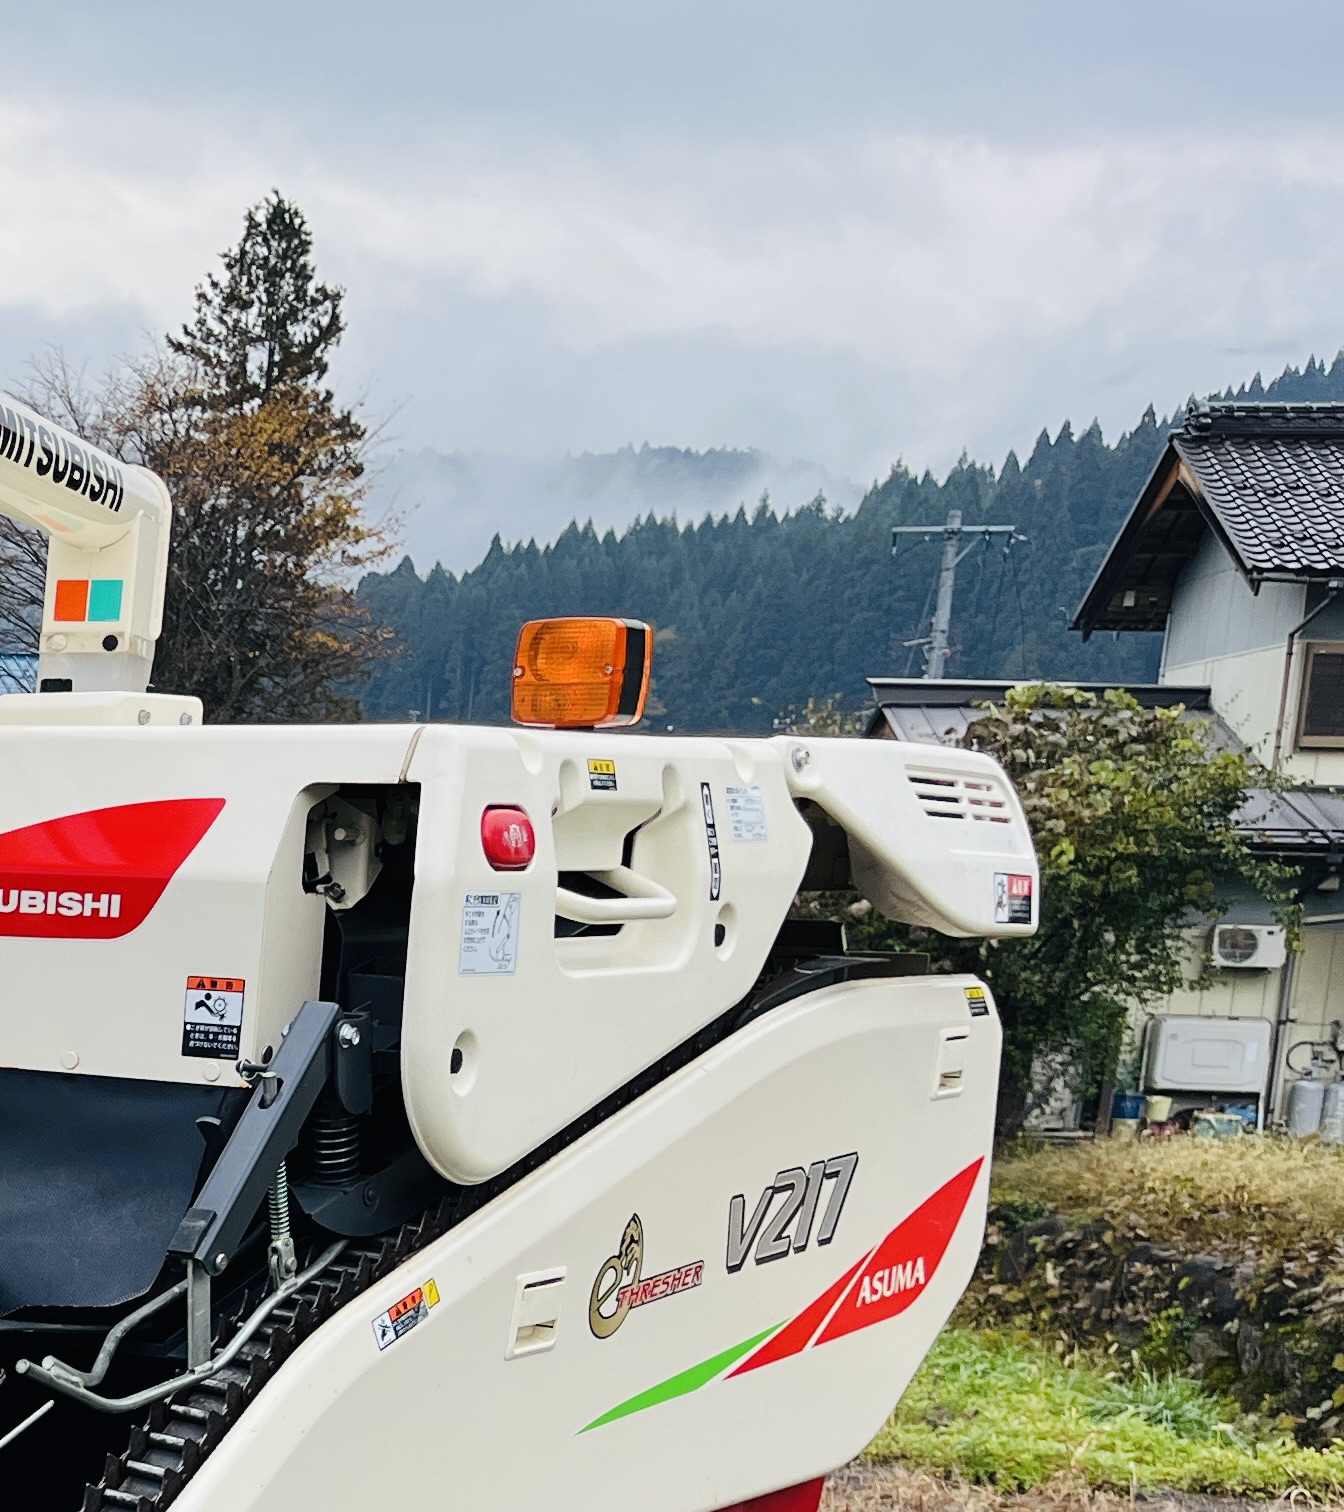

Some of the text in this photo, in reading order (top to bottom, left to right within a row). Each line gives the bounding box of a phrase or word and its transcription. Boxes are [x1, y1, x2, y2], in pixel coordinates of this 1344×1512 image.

[726, 1152, 859, 1275] V217
[618, 1261, 704, 1309] THRESHER
[856, 1256, 926, 1308] ASUMA
